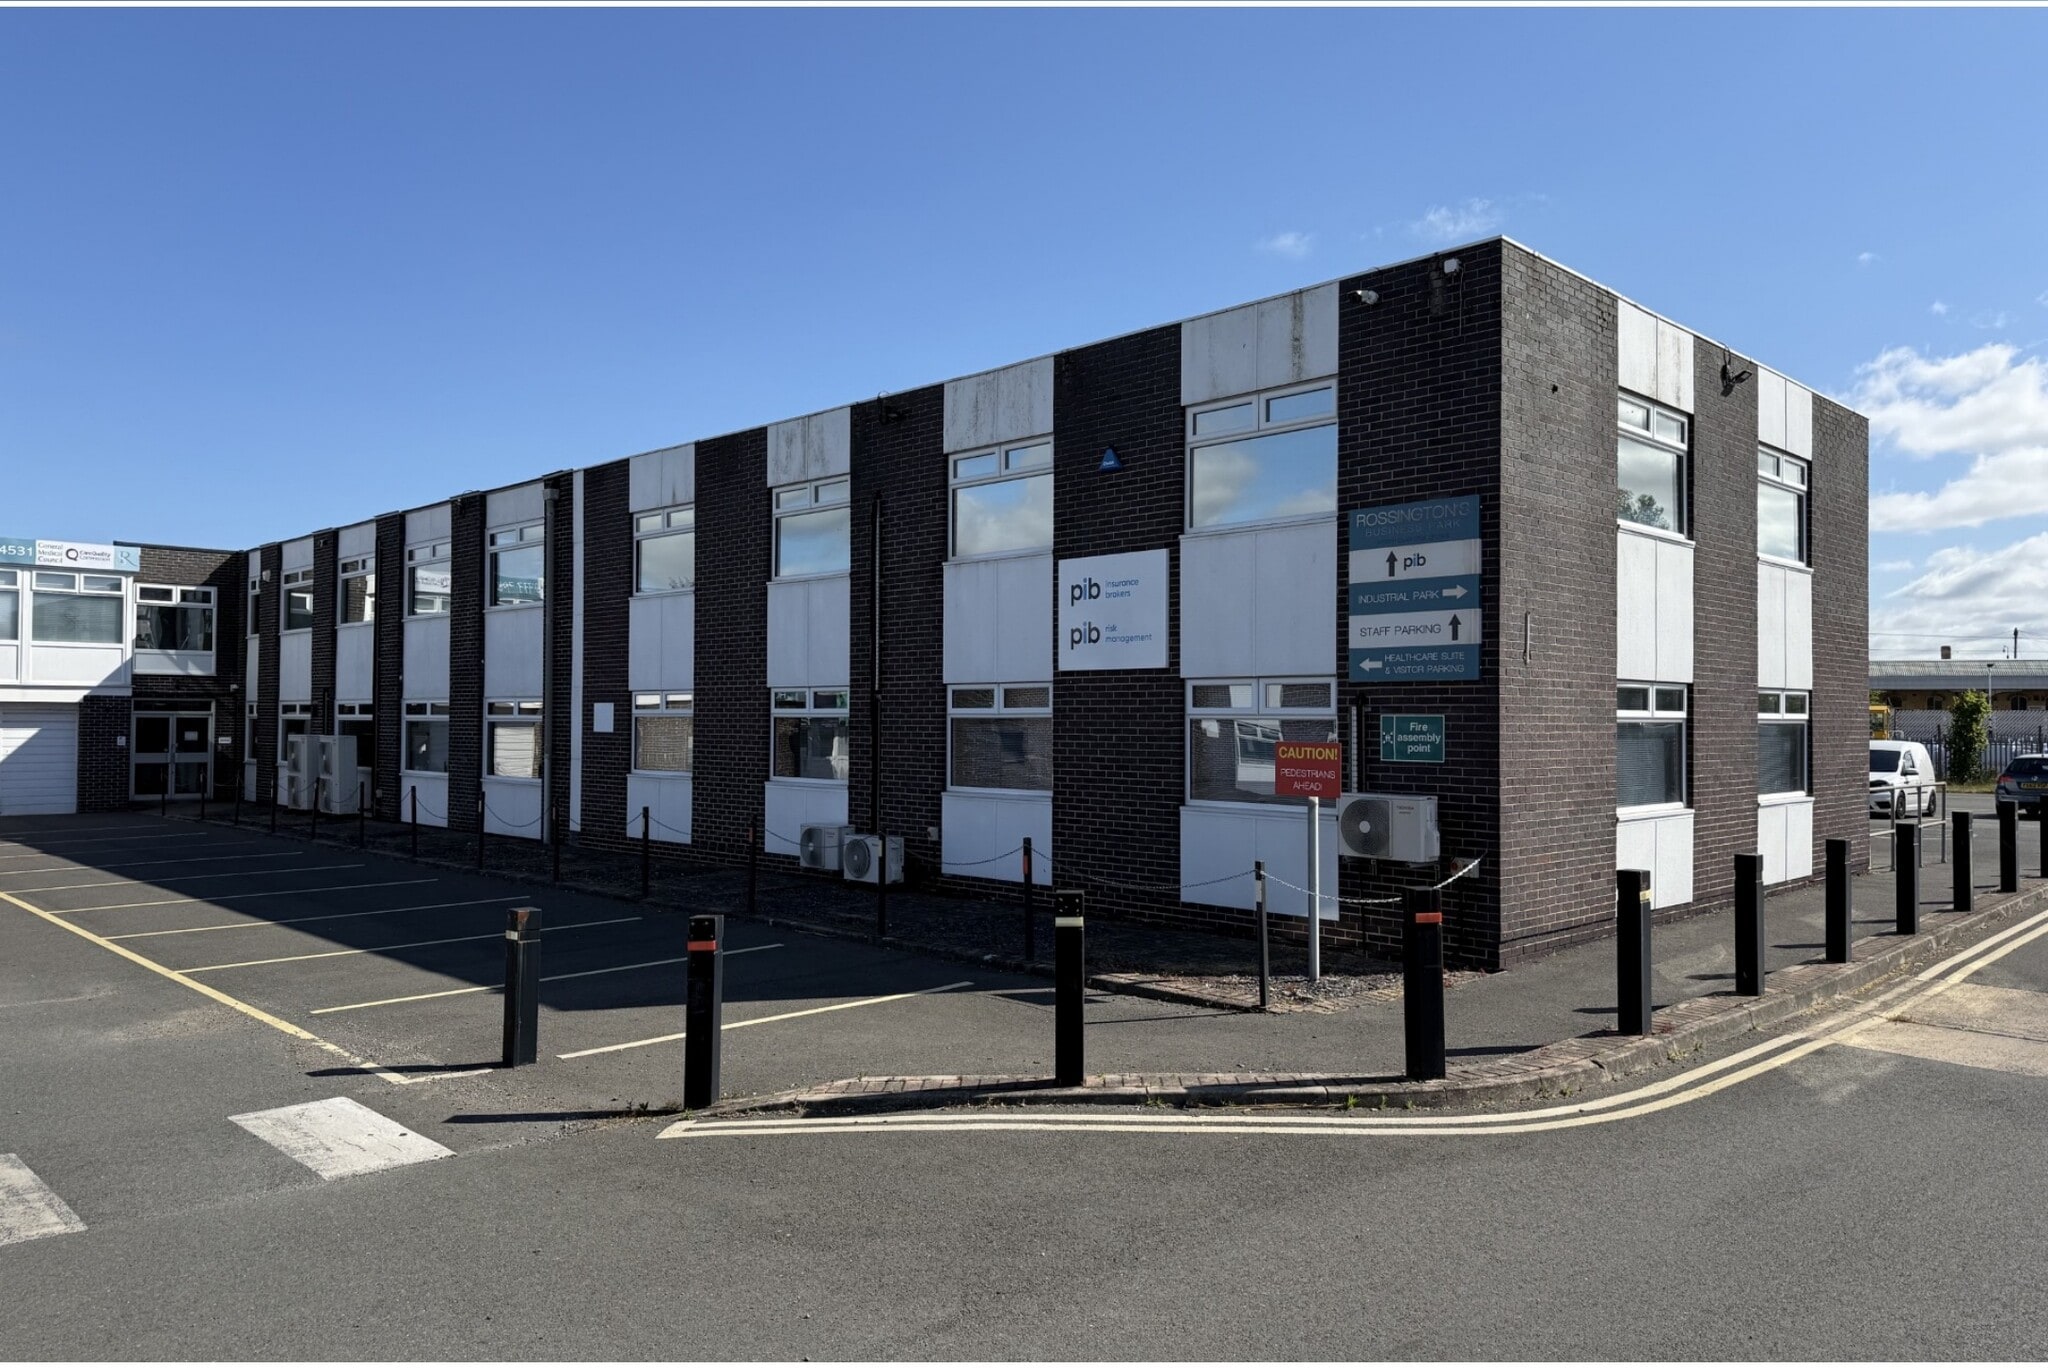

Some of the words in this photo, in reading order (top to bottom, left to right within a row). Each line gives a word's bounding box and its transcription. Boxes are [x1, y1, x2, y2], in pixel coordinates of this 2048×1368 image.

[1403, 553, 1426, 570] pib
[1105, 579, 1139, 587] insurance
[1071, 577, 1101, 607] pib
[1105, 590, 1131, 599] brokers
[1358, 593, 1409, 604] INDUSTRIAL
[1412, 590, 1440, 600] PARK
[1105, 624, 1118, 632] risk
[1360, 626, 1391, 637] STAFF
[1394, 624, 1442, 635] PARKING
[1071, 621, 1101, 650] pib
[1105, 634, 1152, 643] management
[1384, 653, 1438, 662] HEALTHCARE
[1441, 651, 1465, 660] SUITE
[1394, 665, 1425, 674] VISITOR
[1427, 664, 1465, 673] PARKING
[1410, 722, 1428, 731] Fire
[1397, 733, 1441, 744] assembly
[1279, 746, 1338, 760] CAUTION!
[1407, 744, 1431, 754] point
[1280, 768, 1336, 780] PEDESTRIANS
